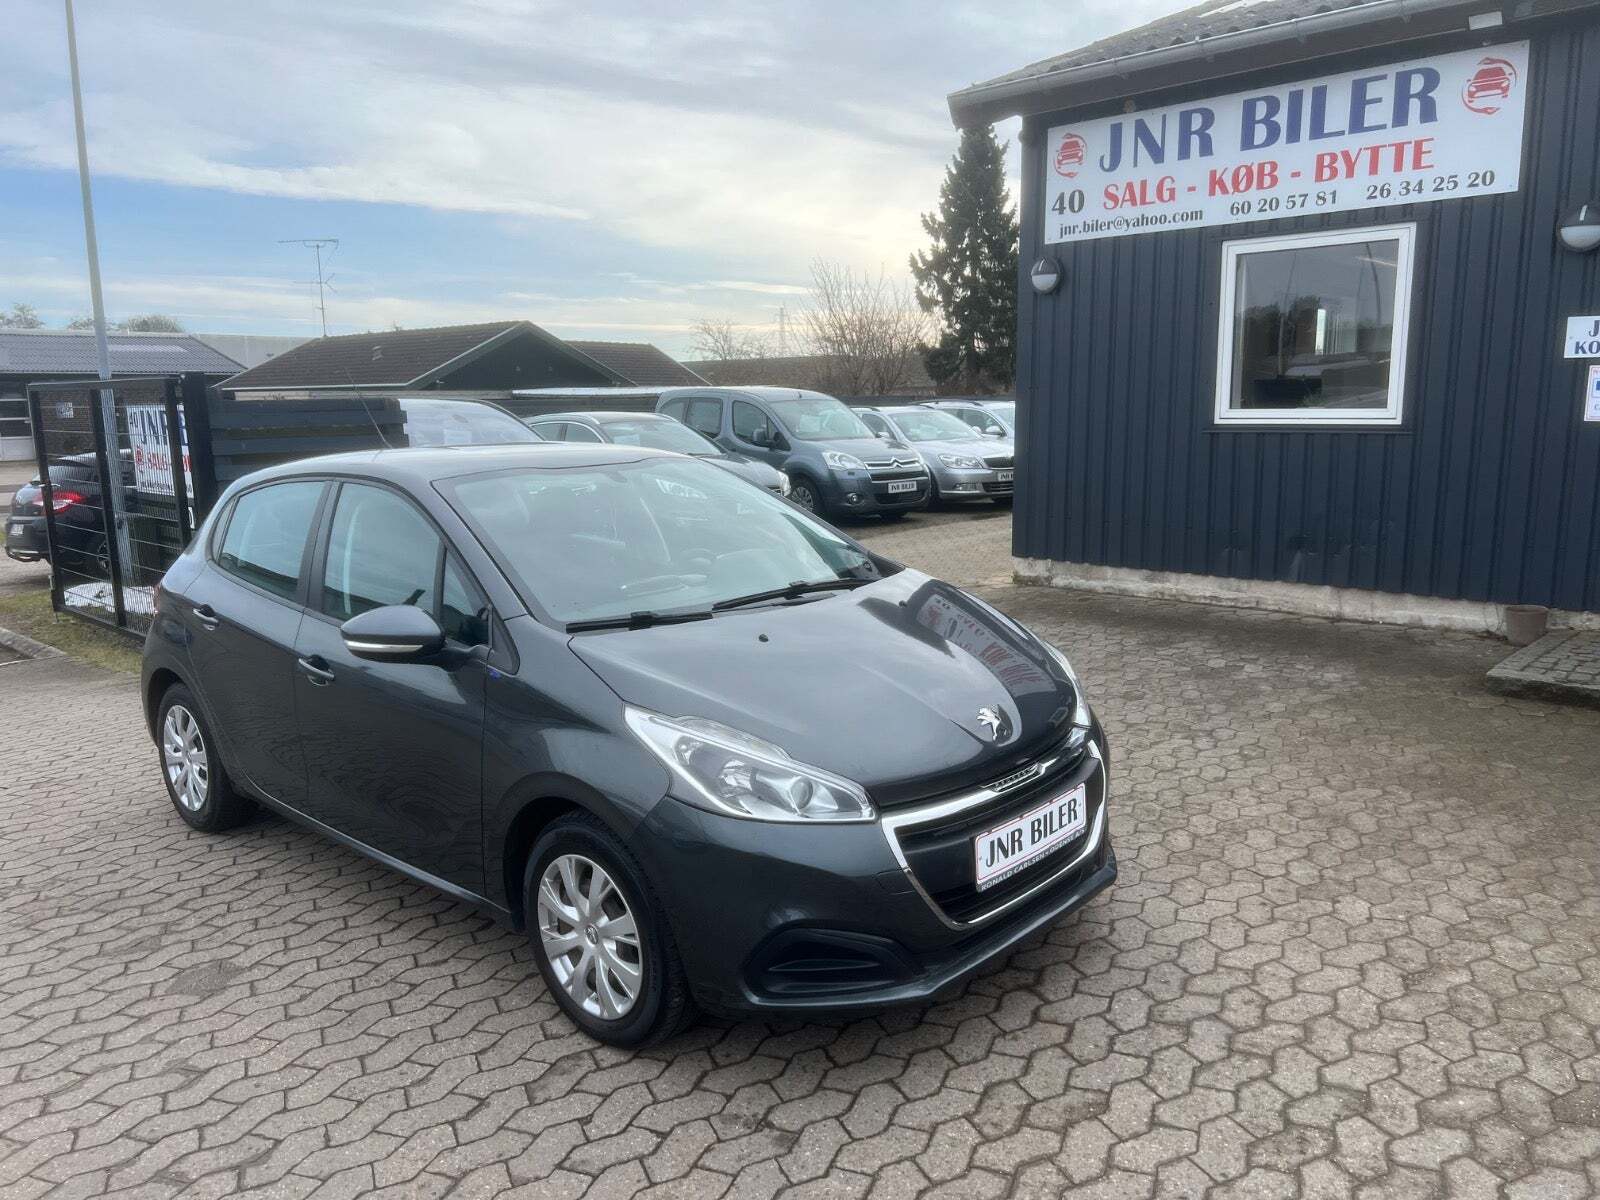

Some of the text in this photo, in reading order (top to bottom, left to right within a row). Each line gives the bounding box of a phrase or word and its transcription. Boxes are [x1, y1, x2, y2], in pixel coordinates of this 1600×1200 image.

[1099, 67, 1441, 172] JNR BILER
[1103, 175, 1176, 211] SALG
[1208, 160, 1279, 196] KØB
[1315, 137, 1434, 183] BYTTE
[1366, 170, 1495, 200] 26 34 25 20
[1052, 189, 1085, 215] 40
[1230, 190, 1337, 216] 60 20 57 81
[1059, 209, 1203, 239] jnr.biler@yahoo.com
[986, 797, 1078, 868] JNR BILER
[981, 871, 1013, 892] RONALD
[1013, 852, 1046, 873] CARLSEN
